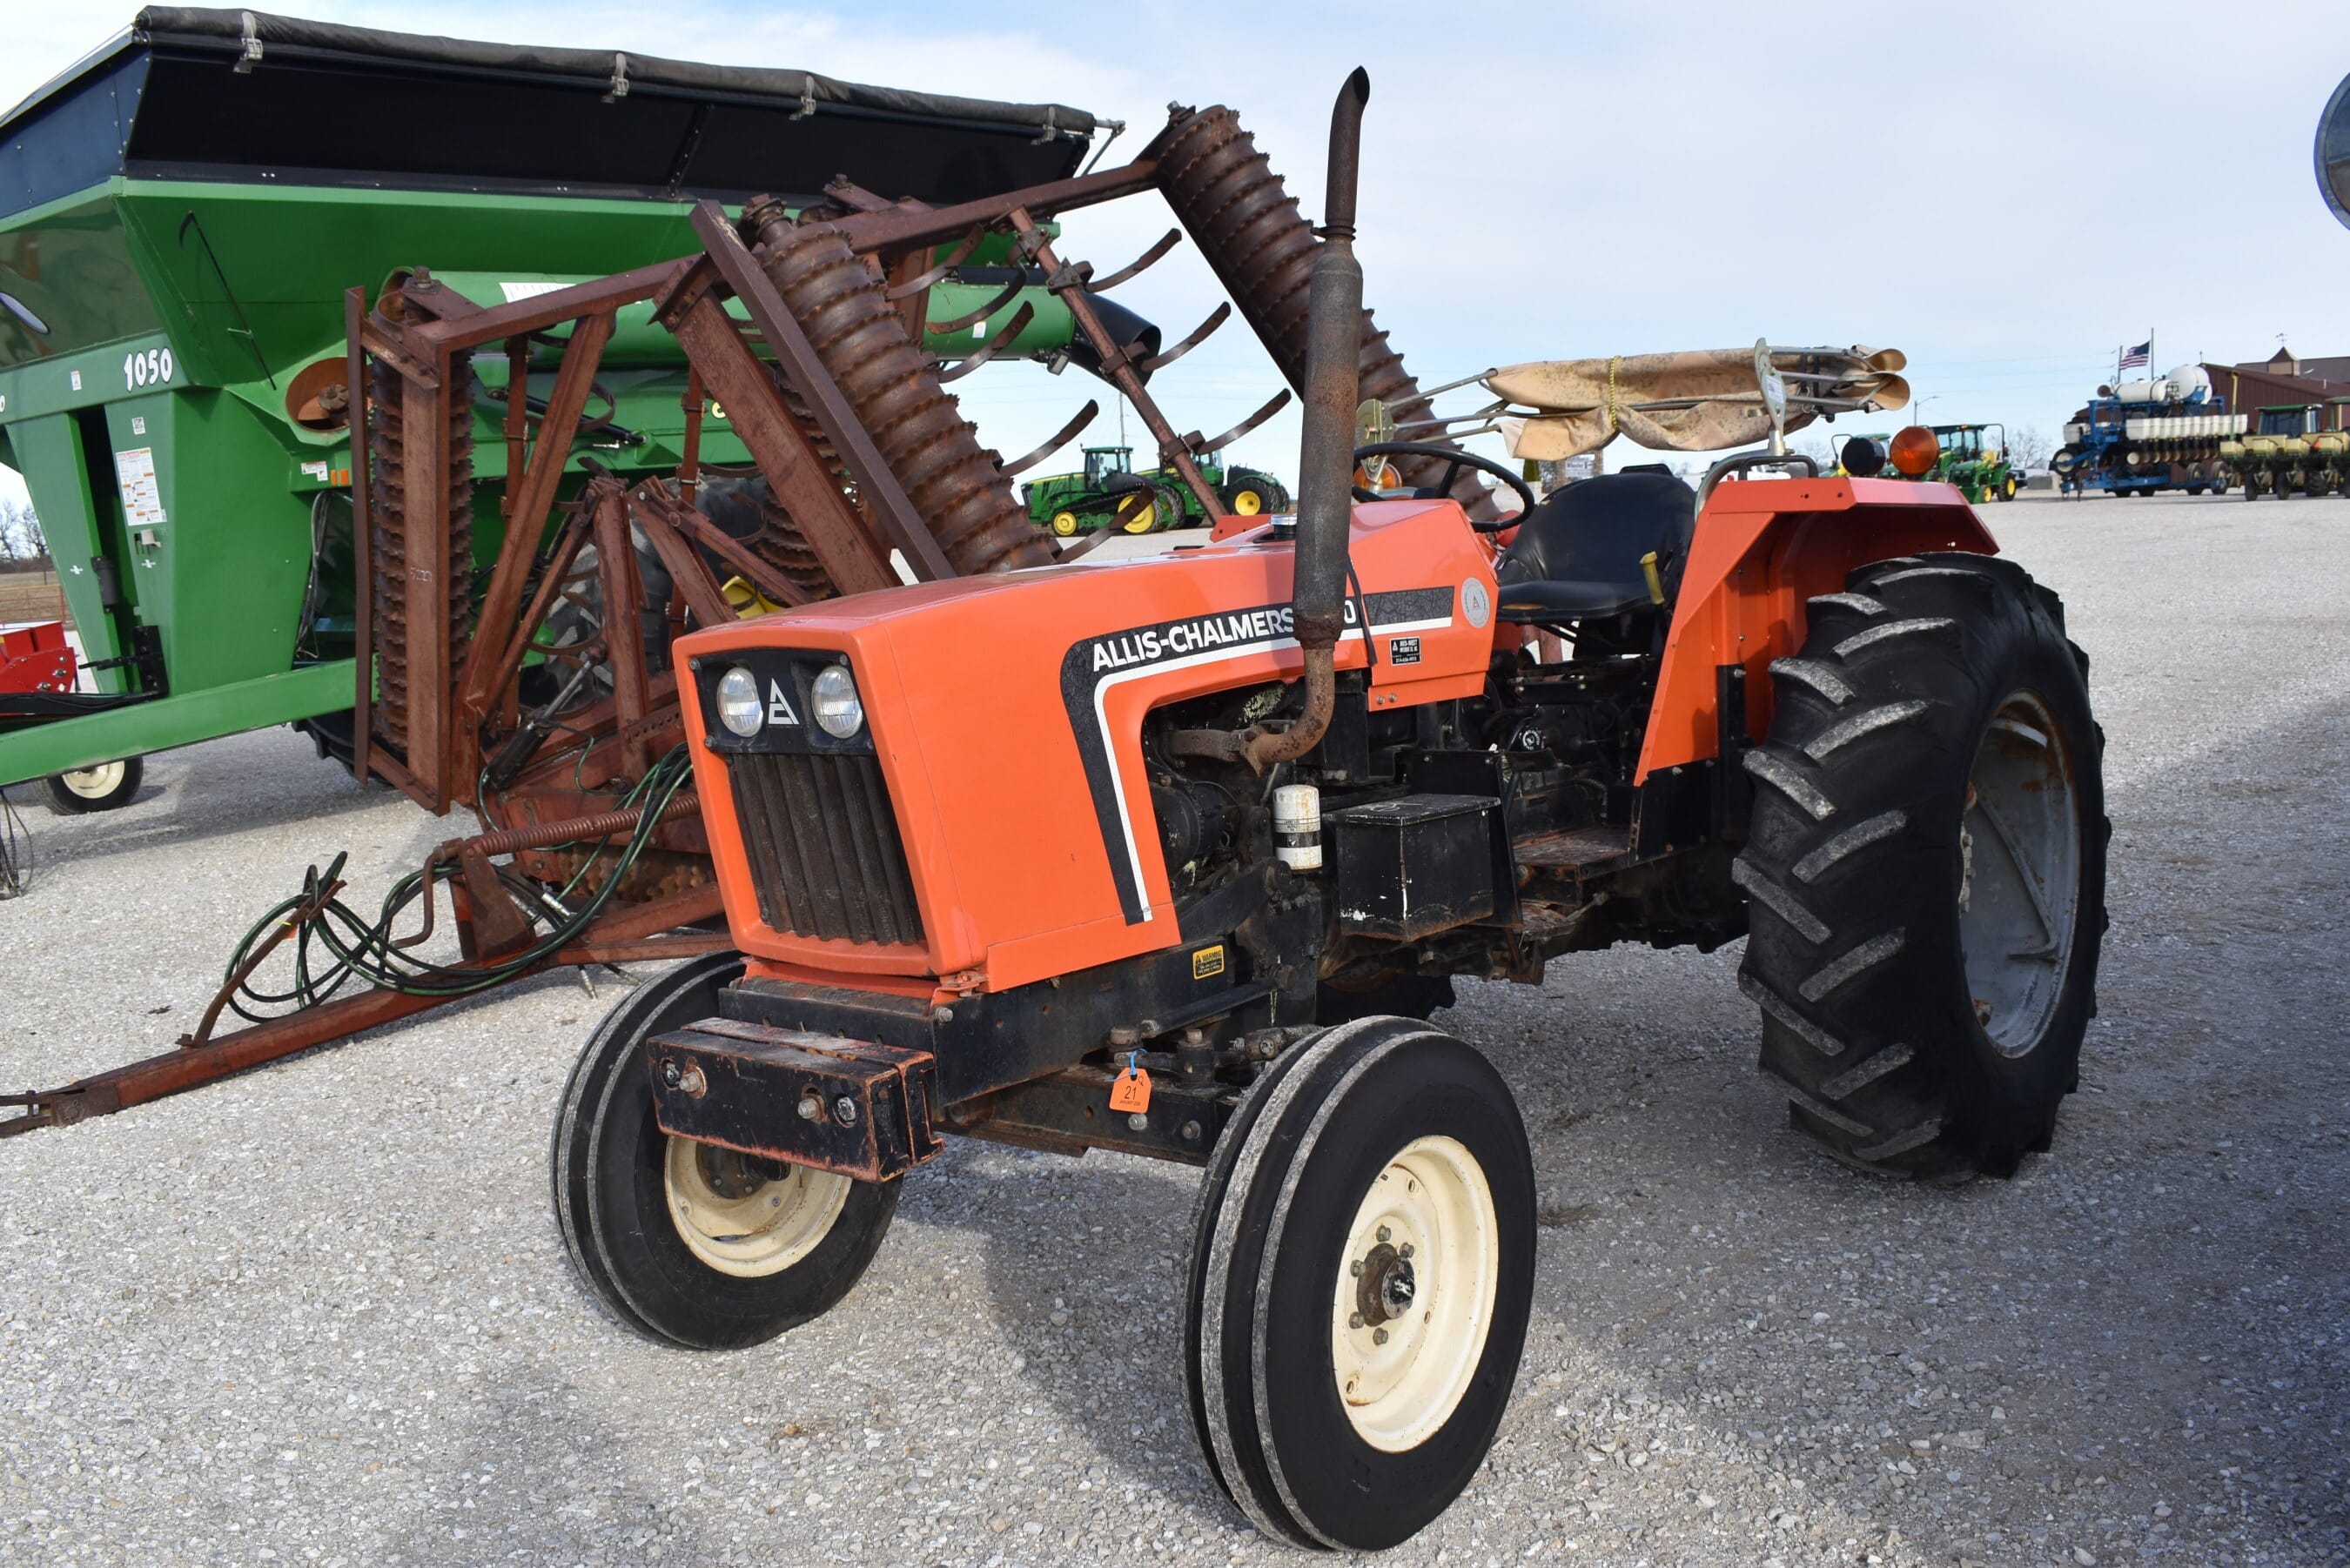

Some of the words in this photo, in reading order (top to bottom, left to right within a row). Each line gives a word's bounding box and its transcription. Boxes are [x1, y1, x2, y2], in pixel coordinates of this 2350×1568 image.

[124, 347, 173, 392] 1050
[1093, 607, 1294, 672] ALLIS-CHALMERS
[1125, 1086, 1137, 1100] 21
